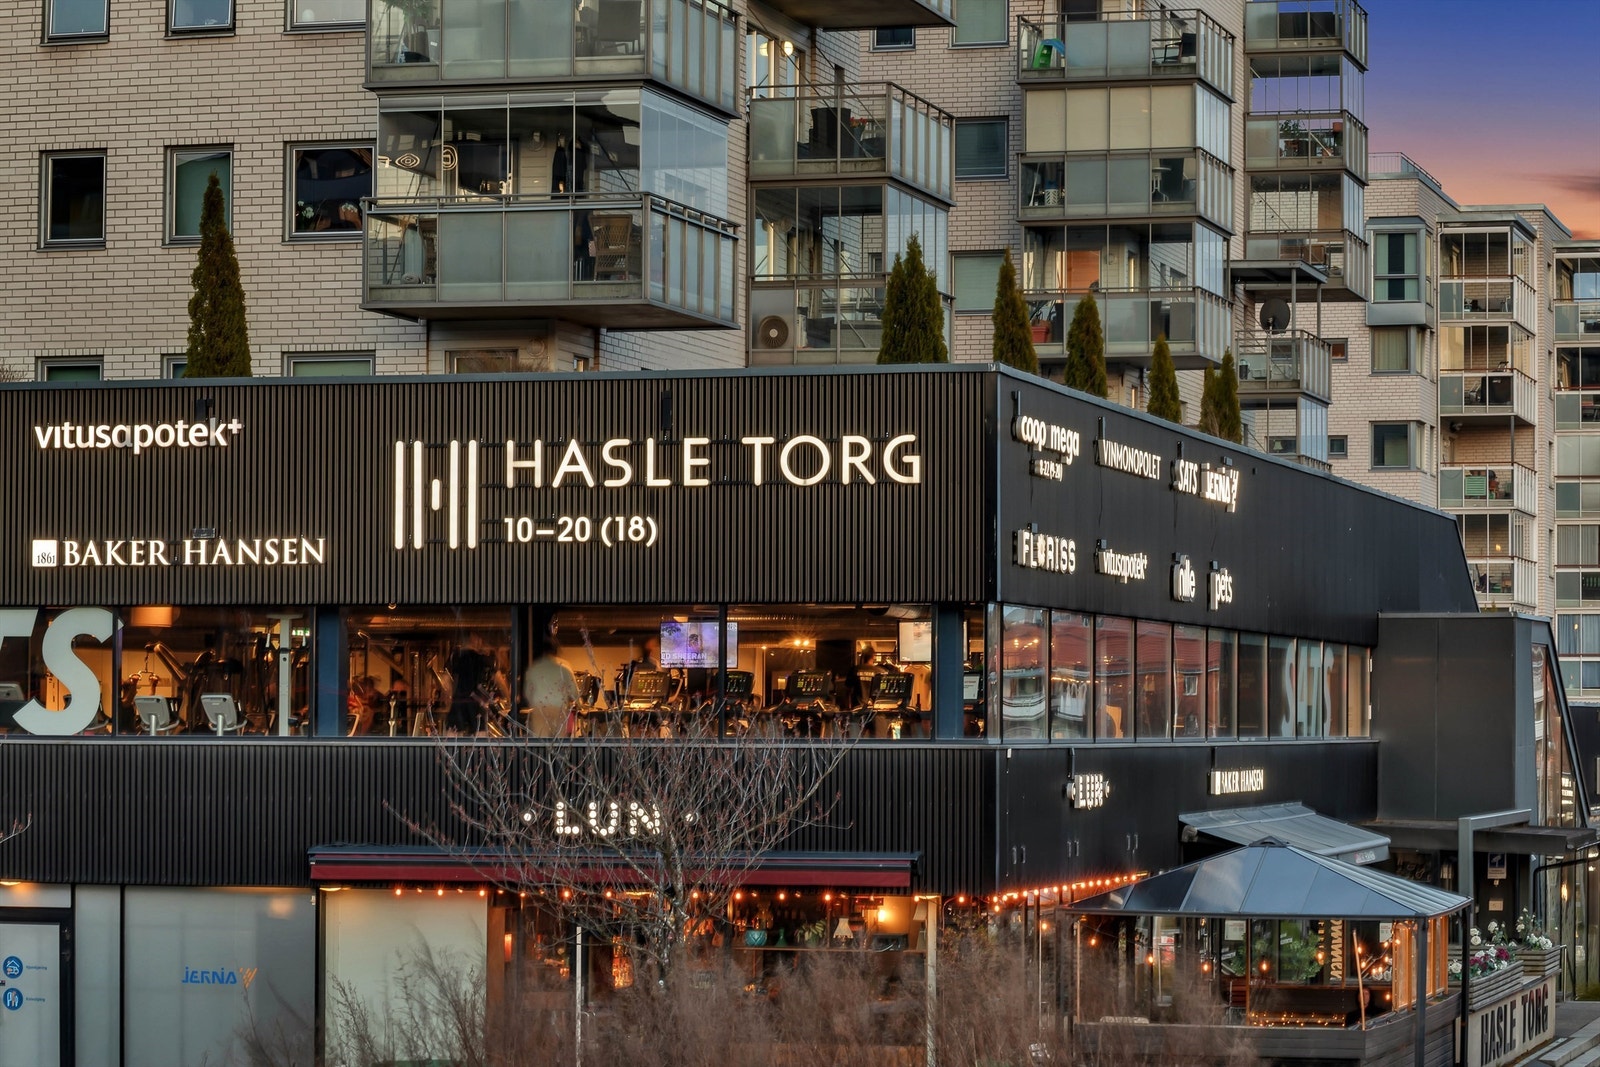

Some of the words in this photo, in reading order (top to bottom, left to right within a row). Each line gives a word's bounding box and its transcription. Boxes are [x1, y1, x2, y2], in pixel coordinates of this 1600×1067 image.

[506, 437, 710, 488] HASLE
[741, 434, 921, 486] TORG
[1021, 415, 1047, 452] coop
[1050, 424, 1080, 466] mega
[1102, 439, 1161, 480] VINMONOPOLET
[1178, 459, 1198, 495] SATS
[63, 539, 171, 566] BAKER
[183, 538, 326, 565] HANSEN
[600, 515, 658, 548] (18)
[36, 551, 56, 564] 1861
[1215, 568, 1233, 610] pets
[1281, 641, 1335, 737] SATS
[556, 801, 661, 836] LUN
[1481, 999, 1517, 1067] HASLE
[1521, 983, 1549, 1043] TORG
